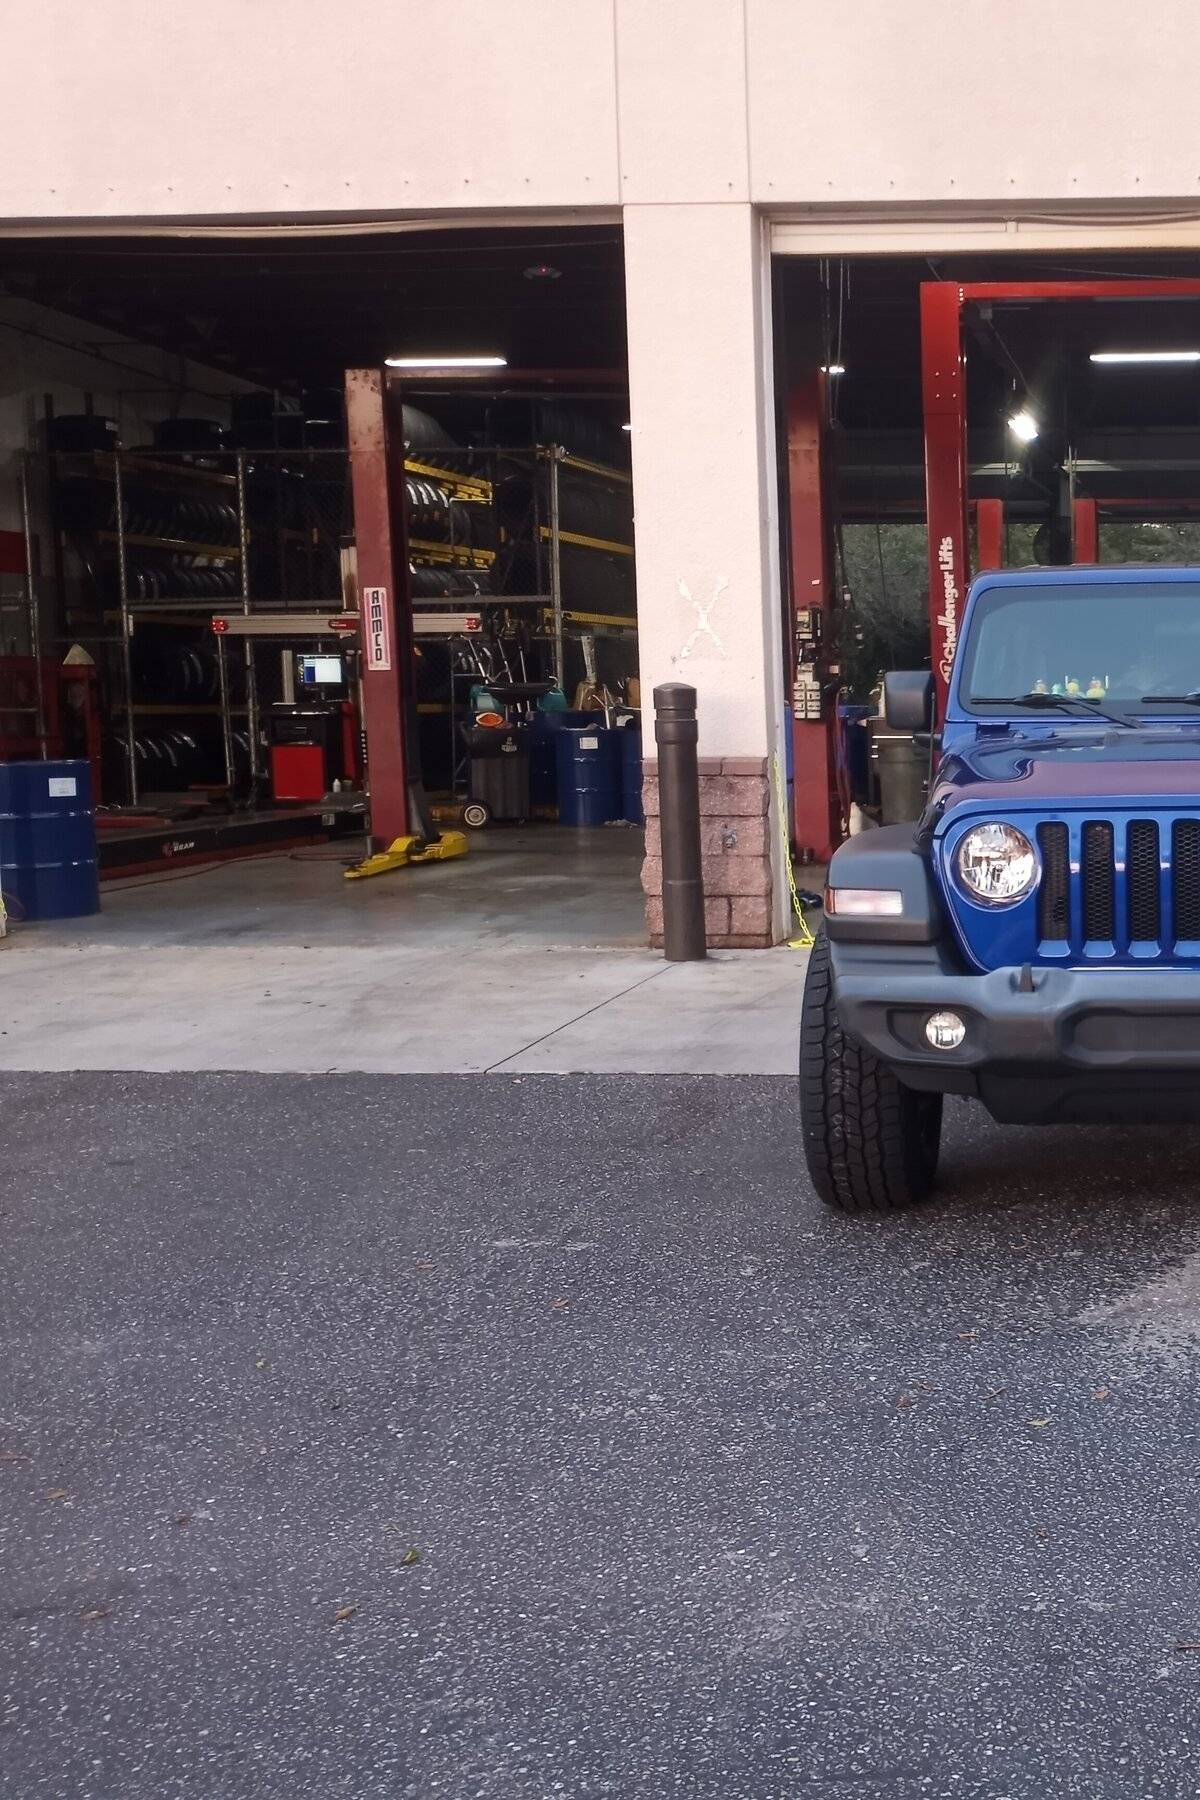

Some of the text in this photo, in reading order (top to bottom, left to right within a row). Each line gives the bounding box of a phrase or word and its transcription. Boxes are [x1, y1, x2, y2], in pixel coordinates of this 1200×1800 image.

[939, 535, 954, 571] Lifts
[371, 590, 383, 662] AMMCO
[937, 571, 959, 661] Challenger
